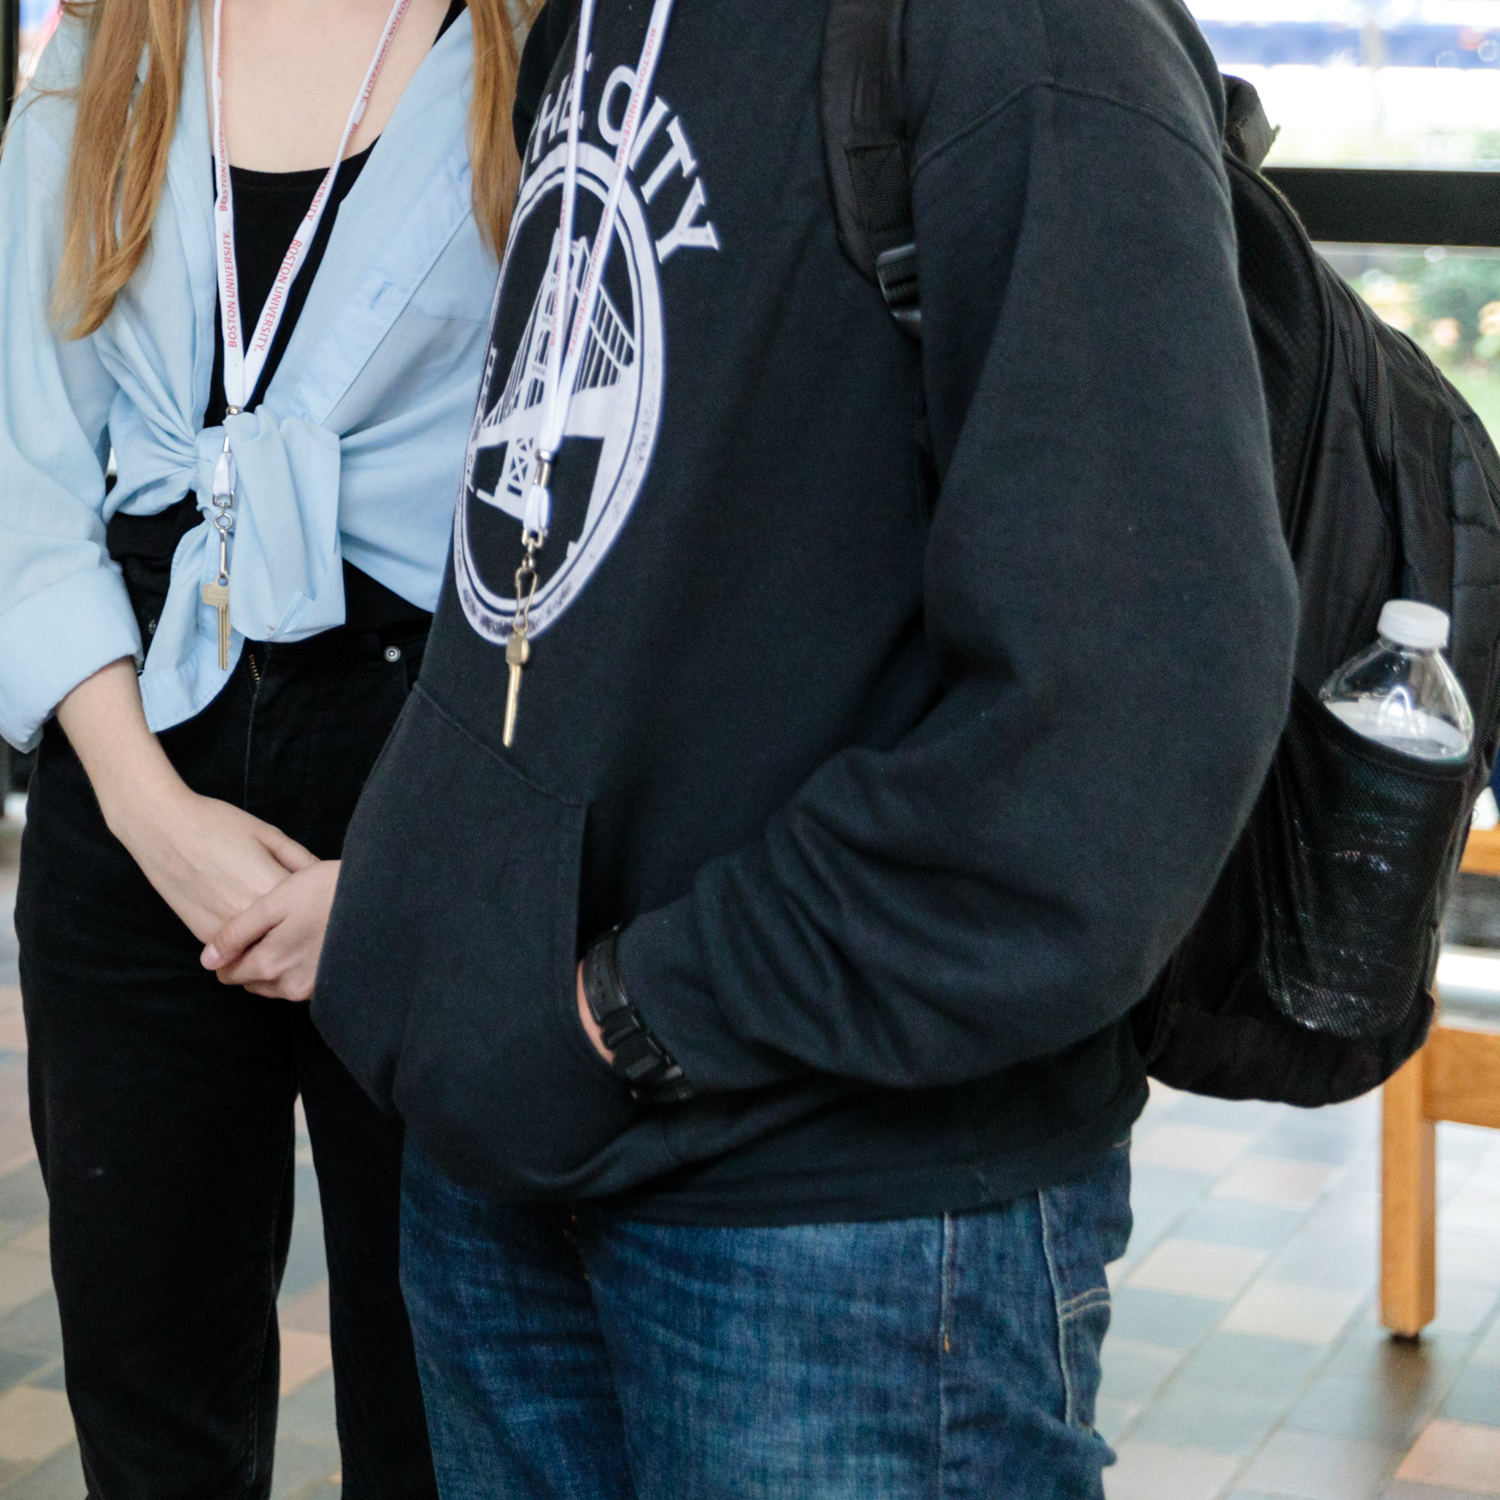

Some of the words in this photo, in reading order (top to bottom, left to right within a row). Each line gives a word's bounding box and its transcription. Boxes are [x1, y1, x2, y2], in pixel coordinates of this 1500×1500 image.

[637, 28, 657, 90] BOSTON
[518, 53, 593, 195] HE
[598, 65, 720, 264] CITY
[278, 238, 303, 284] BOSTON
[590, 207, 610, 268] BOSTON
[227, 301, 238, 348] BOSTON
